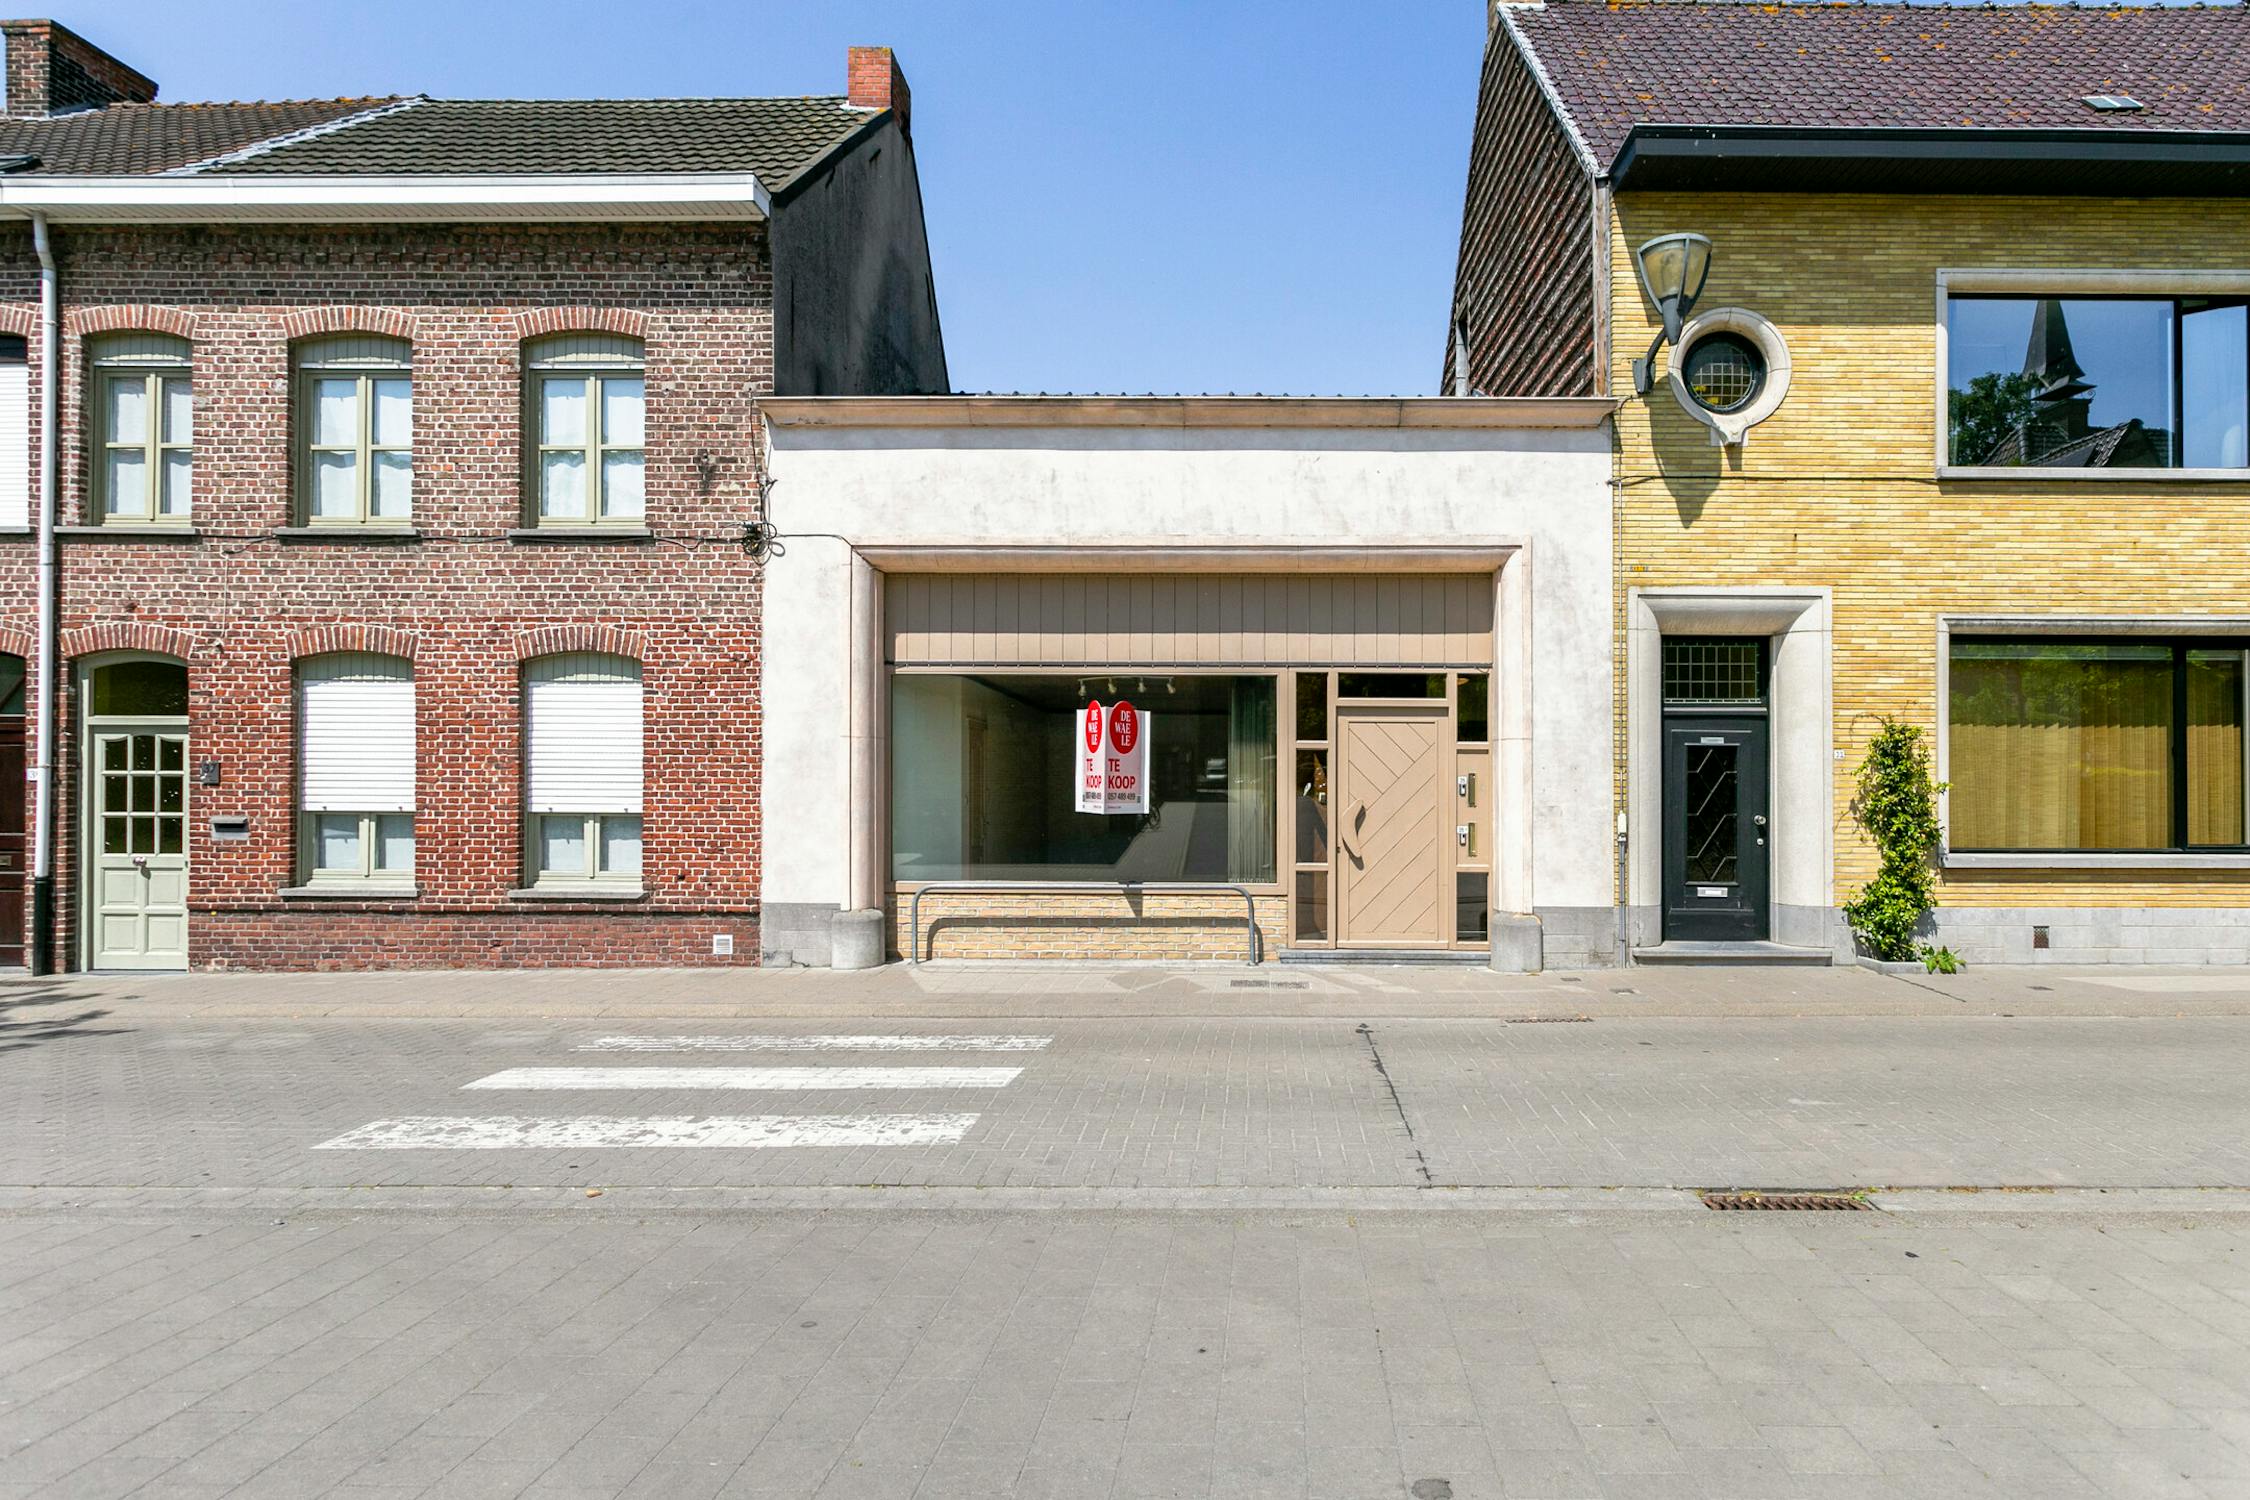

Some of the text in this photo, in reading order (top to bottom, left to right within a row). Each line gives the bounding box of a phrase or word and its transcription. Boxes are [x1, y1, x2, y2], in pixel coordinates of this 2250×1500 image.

[1121, 710, 1131, 722] DE
[1115, 721, 1131, 734] WAE
[1121, 734, 1131, 747] LE
[1086, 758, 1093, 772] TE
[1108, 758, 1120, 772] TE
[1108, 775, 1136, 789] KOOP
